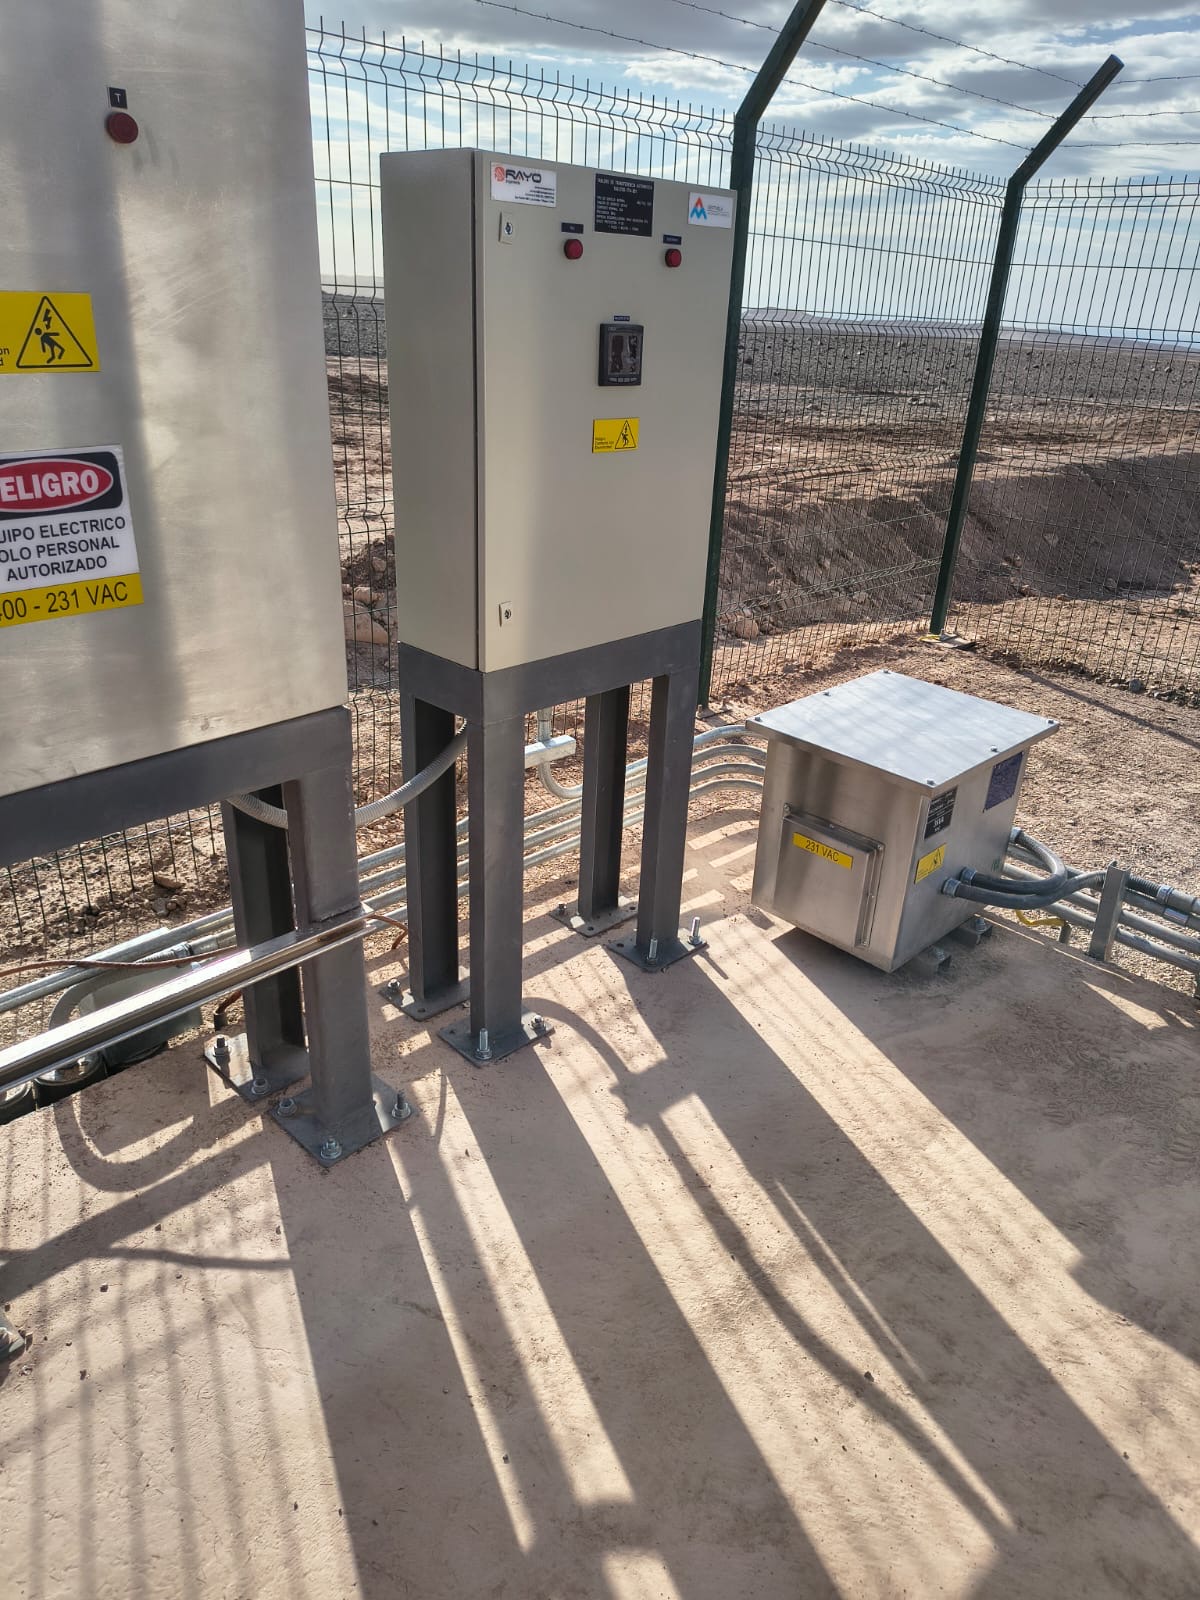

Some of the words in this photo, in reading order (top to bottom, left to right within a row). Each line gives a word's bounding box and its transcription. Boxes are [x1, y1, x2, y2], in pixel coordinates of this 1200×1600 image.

[114, 92, 121, 103] T
[506, 169, 542, 183] RAYO
[39, 516, 126, 538] ELECTRICO
[36, 536, 120, 559] PERSONAL
[7, 555, 108, 581] AUTORIZADO
[0, 597, 27, 620] 00
[46, 589, 80, 613] 231
[85, 581, 128, 605] VAC
[805, 840, 820, 854] 231
[821, 845, 840, 862] VAC
